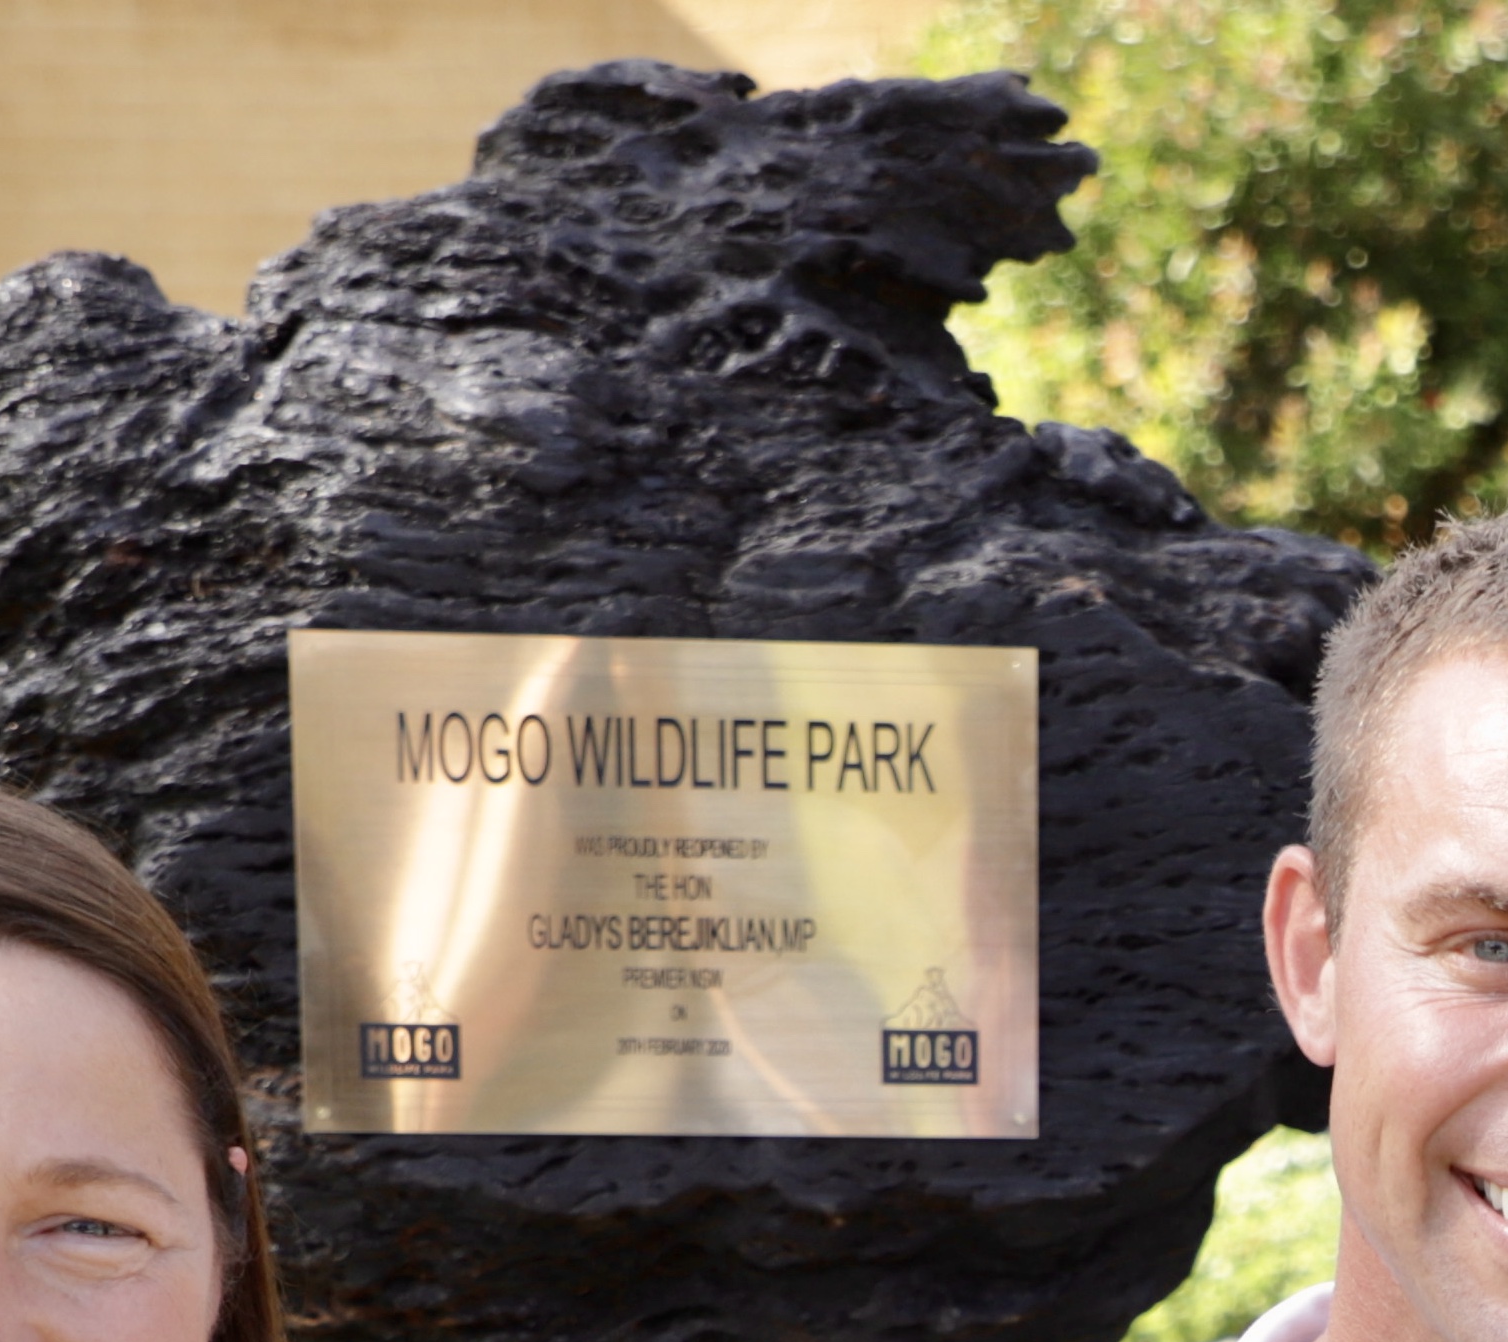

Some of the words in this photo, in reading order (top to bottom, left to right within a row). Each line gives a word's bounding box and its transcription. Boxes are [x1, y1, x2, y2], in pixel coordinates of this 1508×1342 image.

[397, 712, 552, 786] MOGO
[567, 716, 789, 790] WILDLIFE
[808, 720, 936, 793] PARK
[608, 836, 670, 858] PROUDLY
[675, 837, 748, 859] REOPENED
[751, 838, 770, 860] BY
[633, 873, 667, 900] THE
[673, 874, 712, 901] HON
[528, 914, 622, 950] GLADYS
[622, 967, 686, 990] PREMIER
[366, 1026, 454, 1064] MOGO
[889, 1033, 973, 1069] MOGO
